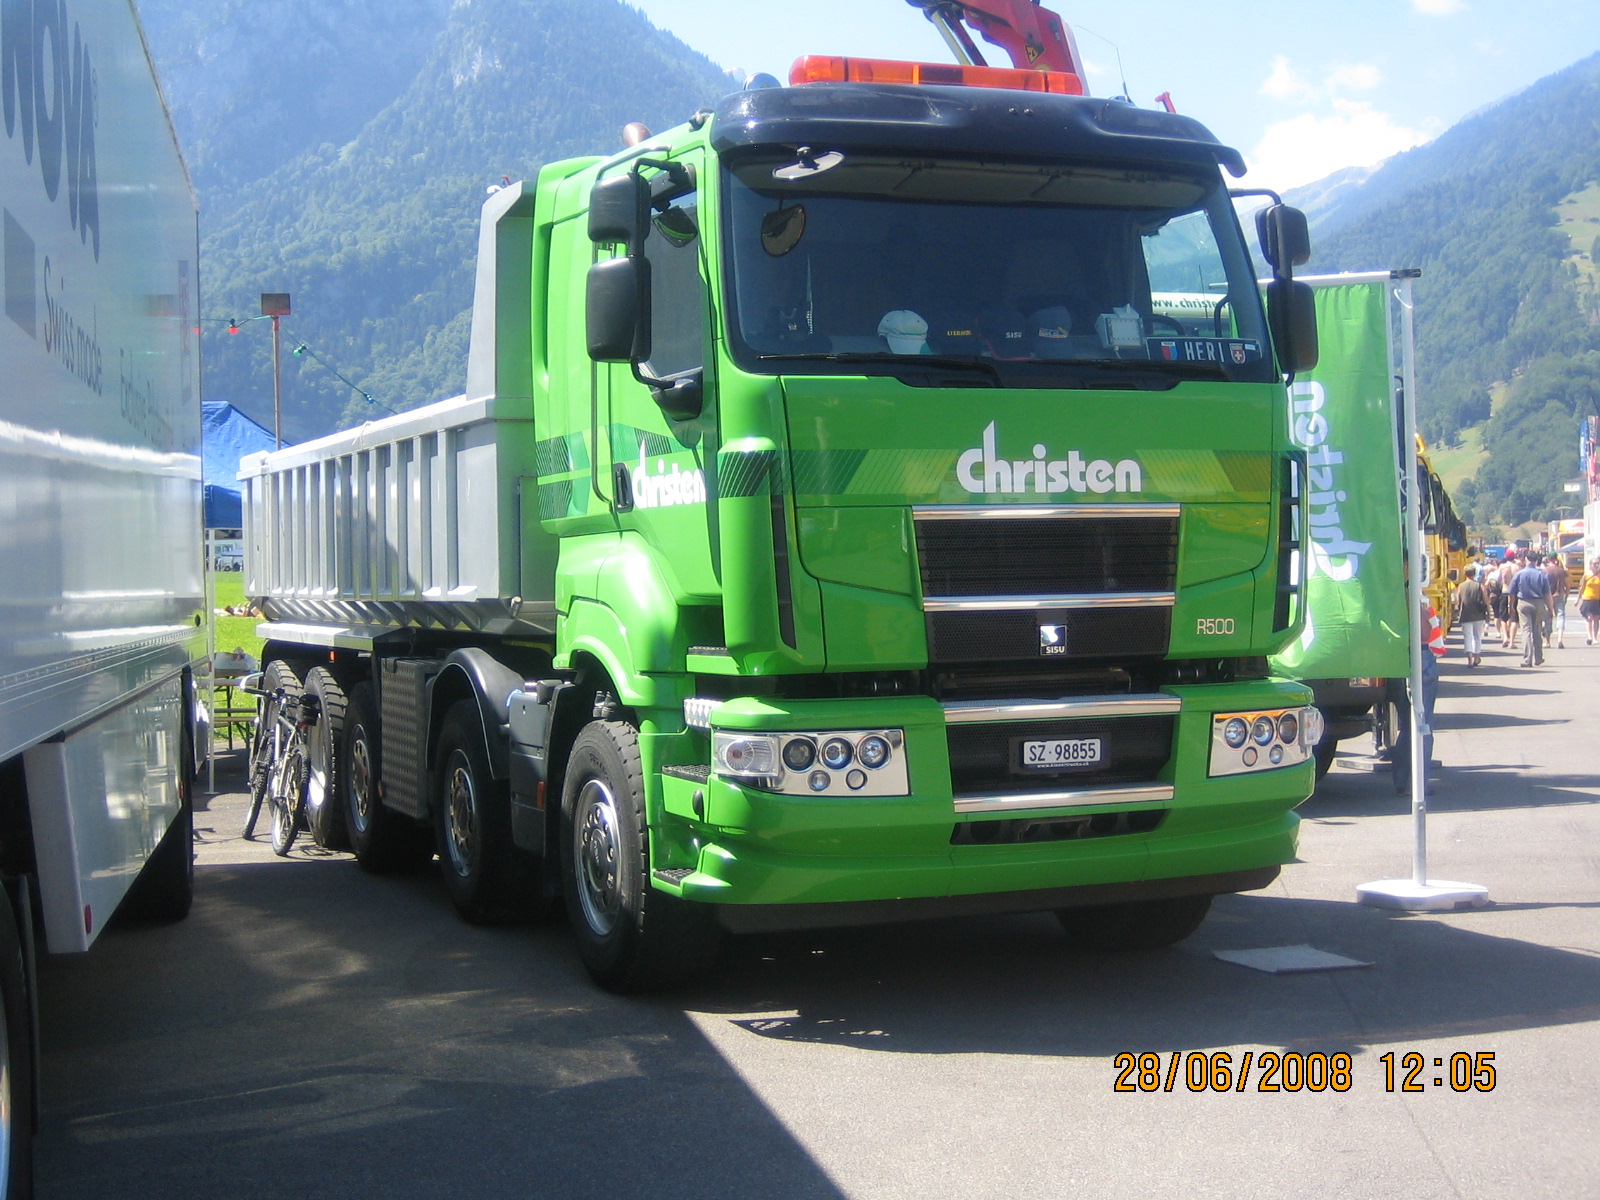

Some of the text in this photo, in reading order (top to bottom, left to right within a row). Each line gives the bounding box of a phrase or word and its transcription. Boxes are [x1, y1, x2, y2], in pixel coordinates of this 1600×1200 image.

[1184, 341, 1224, 362] HERI
[1196, 618, 1235, 635] R500
[1045, 645, 1065, 654] SISU
[1054, 742, 1096, 761] 98855
